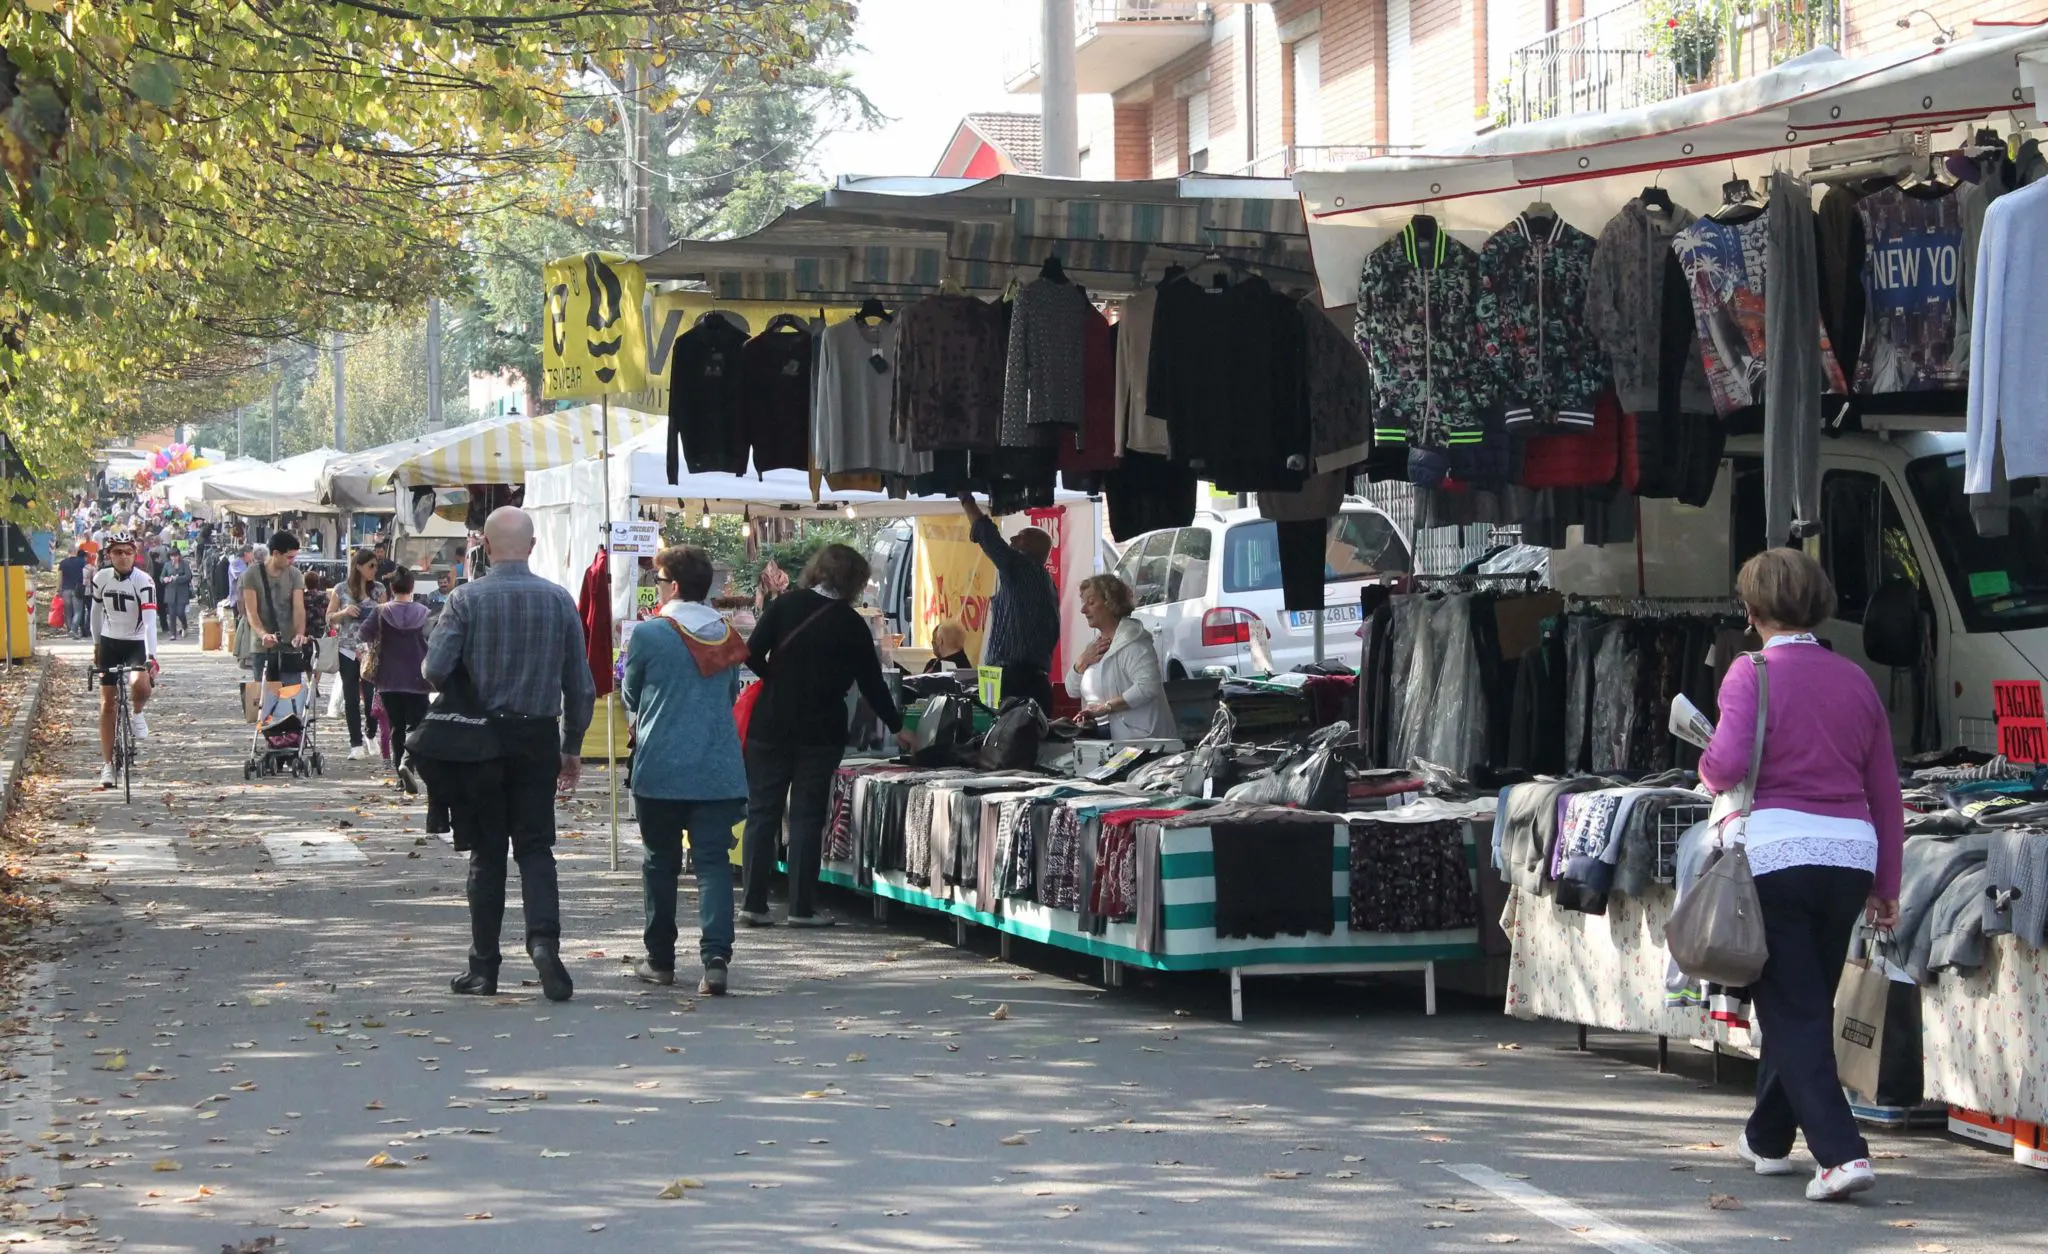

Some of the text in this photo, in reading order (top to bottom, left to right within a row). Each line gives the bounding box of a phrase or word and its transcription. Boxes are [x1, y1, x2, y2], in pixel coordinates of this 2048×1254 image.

[1873, 245, 1957, 290] NEW YO
[543, 366, 582, 391] TSWEAR
[1300, 607, 1356, 624] BZ48LB
[1995, 685, 2044, 718] TAGLIE
[2003, 725, 2045, 760] FORTI
